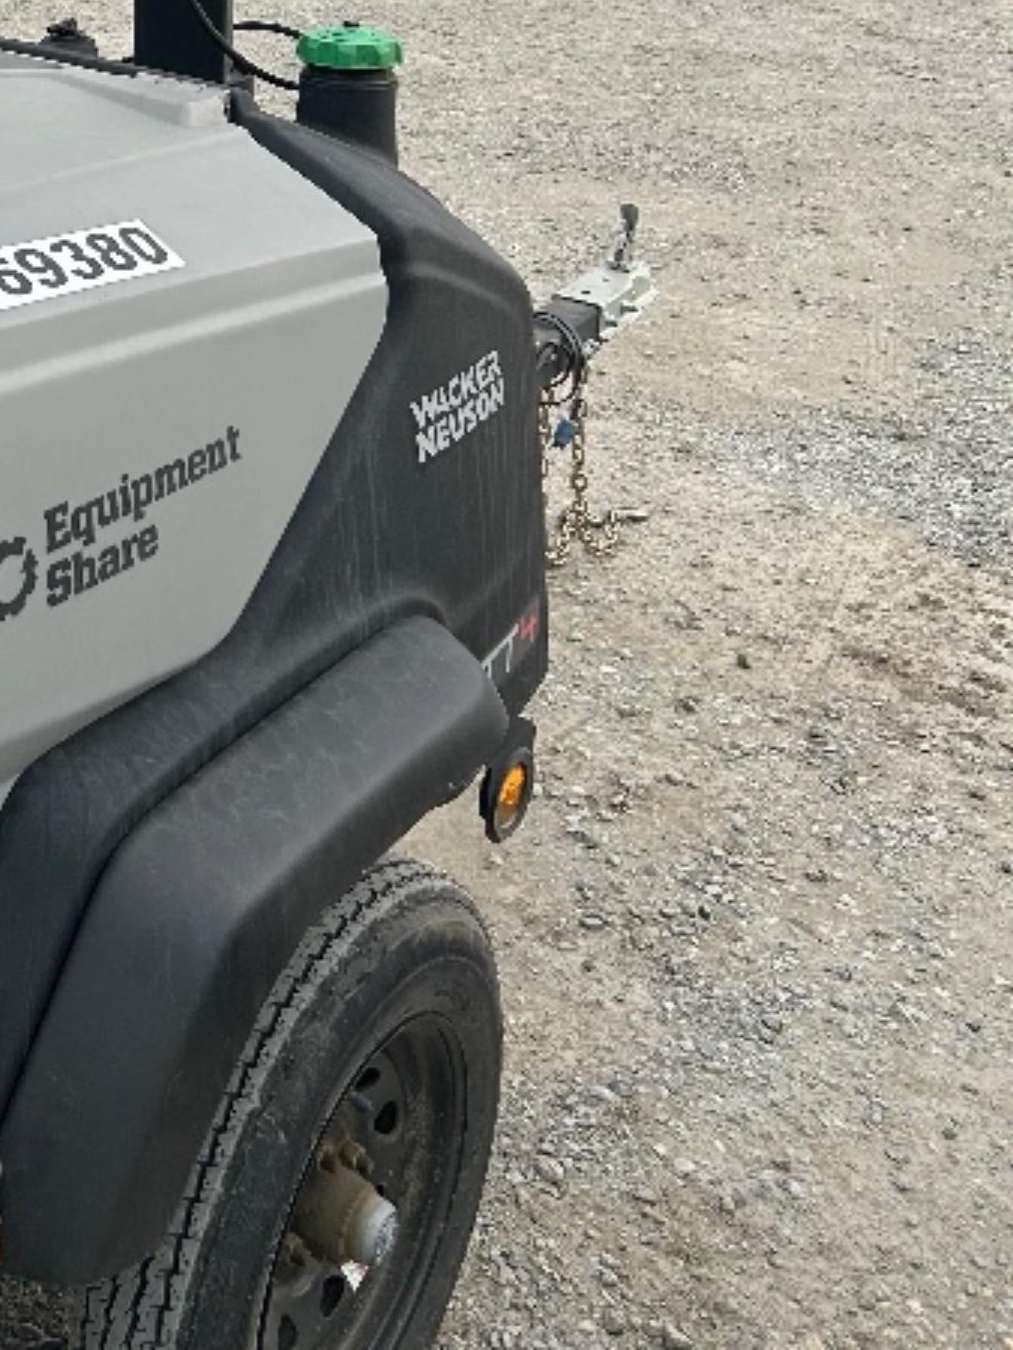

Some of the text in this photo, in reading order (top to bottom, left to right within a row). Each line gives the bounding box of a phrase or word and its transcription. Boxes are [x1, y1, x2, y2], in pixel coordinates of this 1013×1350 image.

[409, 350, 500, 426] WACKER
[416, 378, 506, 463] NEUSON
[44, 425, 242, 553] Equipment
[45, 523, 160, 608] Share
